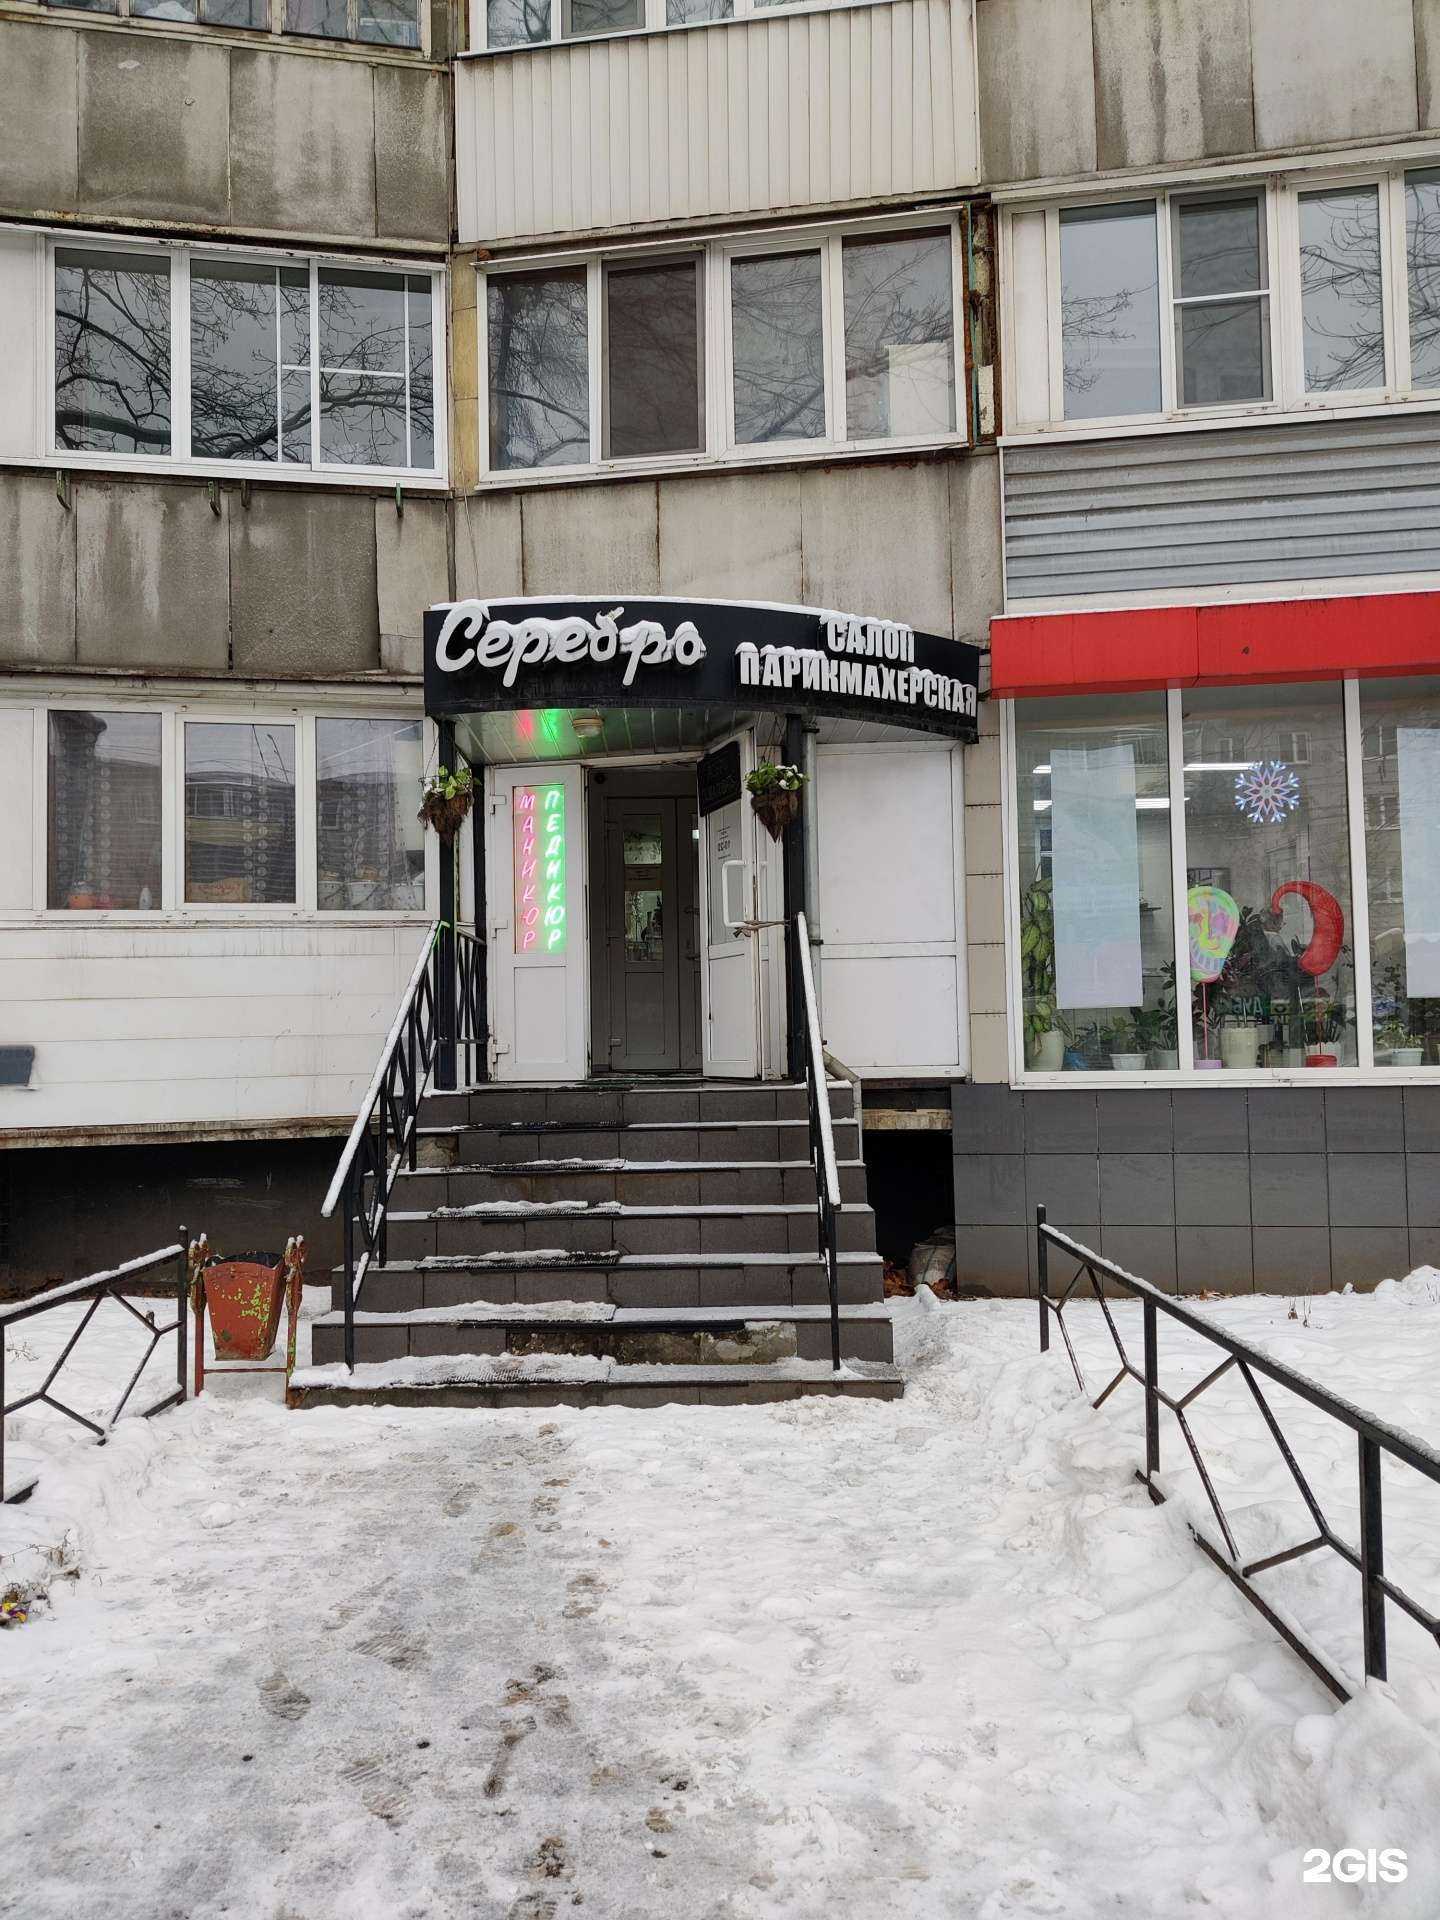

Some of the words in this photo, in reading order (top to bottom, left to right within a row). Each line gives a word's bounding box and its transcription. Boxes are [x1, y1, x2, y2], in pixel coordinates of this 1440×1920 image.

[435, 604, 704, 687] Серебро
[827, 617, 915, 663] САЛОН
[739, 649, 977, 718] ПАРИКМАХЕРСКАЯ
[520, 794, 539, 949] МАНИКЮР
[544, 790, 565, 950] ПЕДИКЮР
